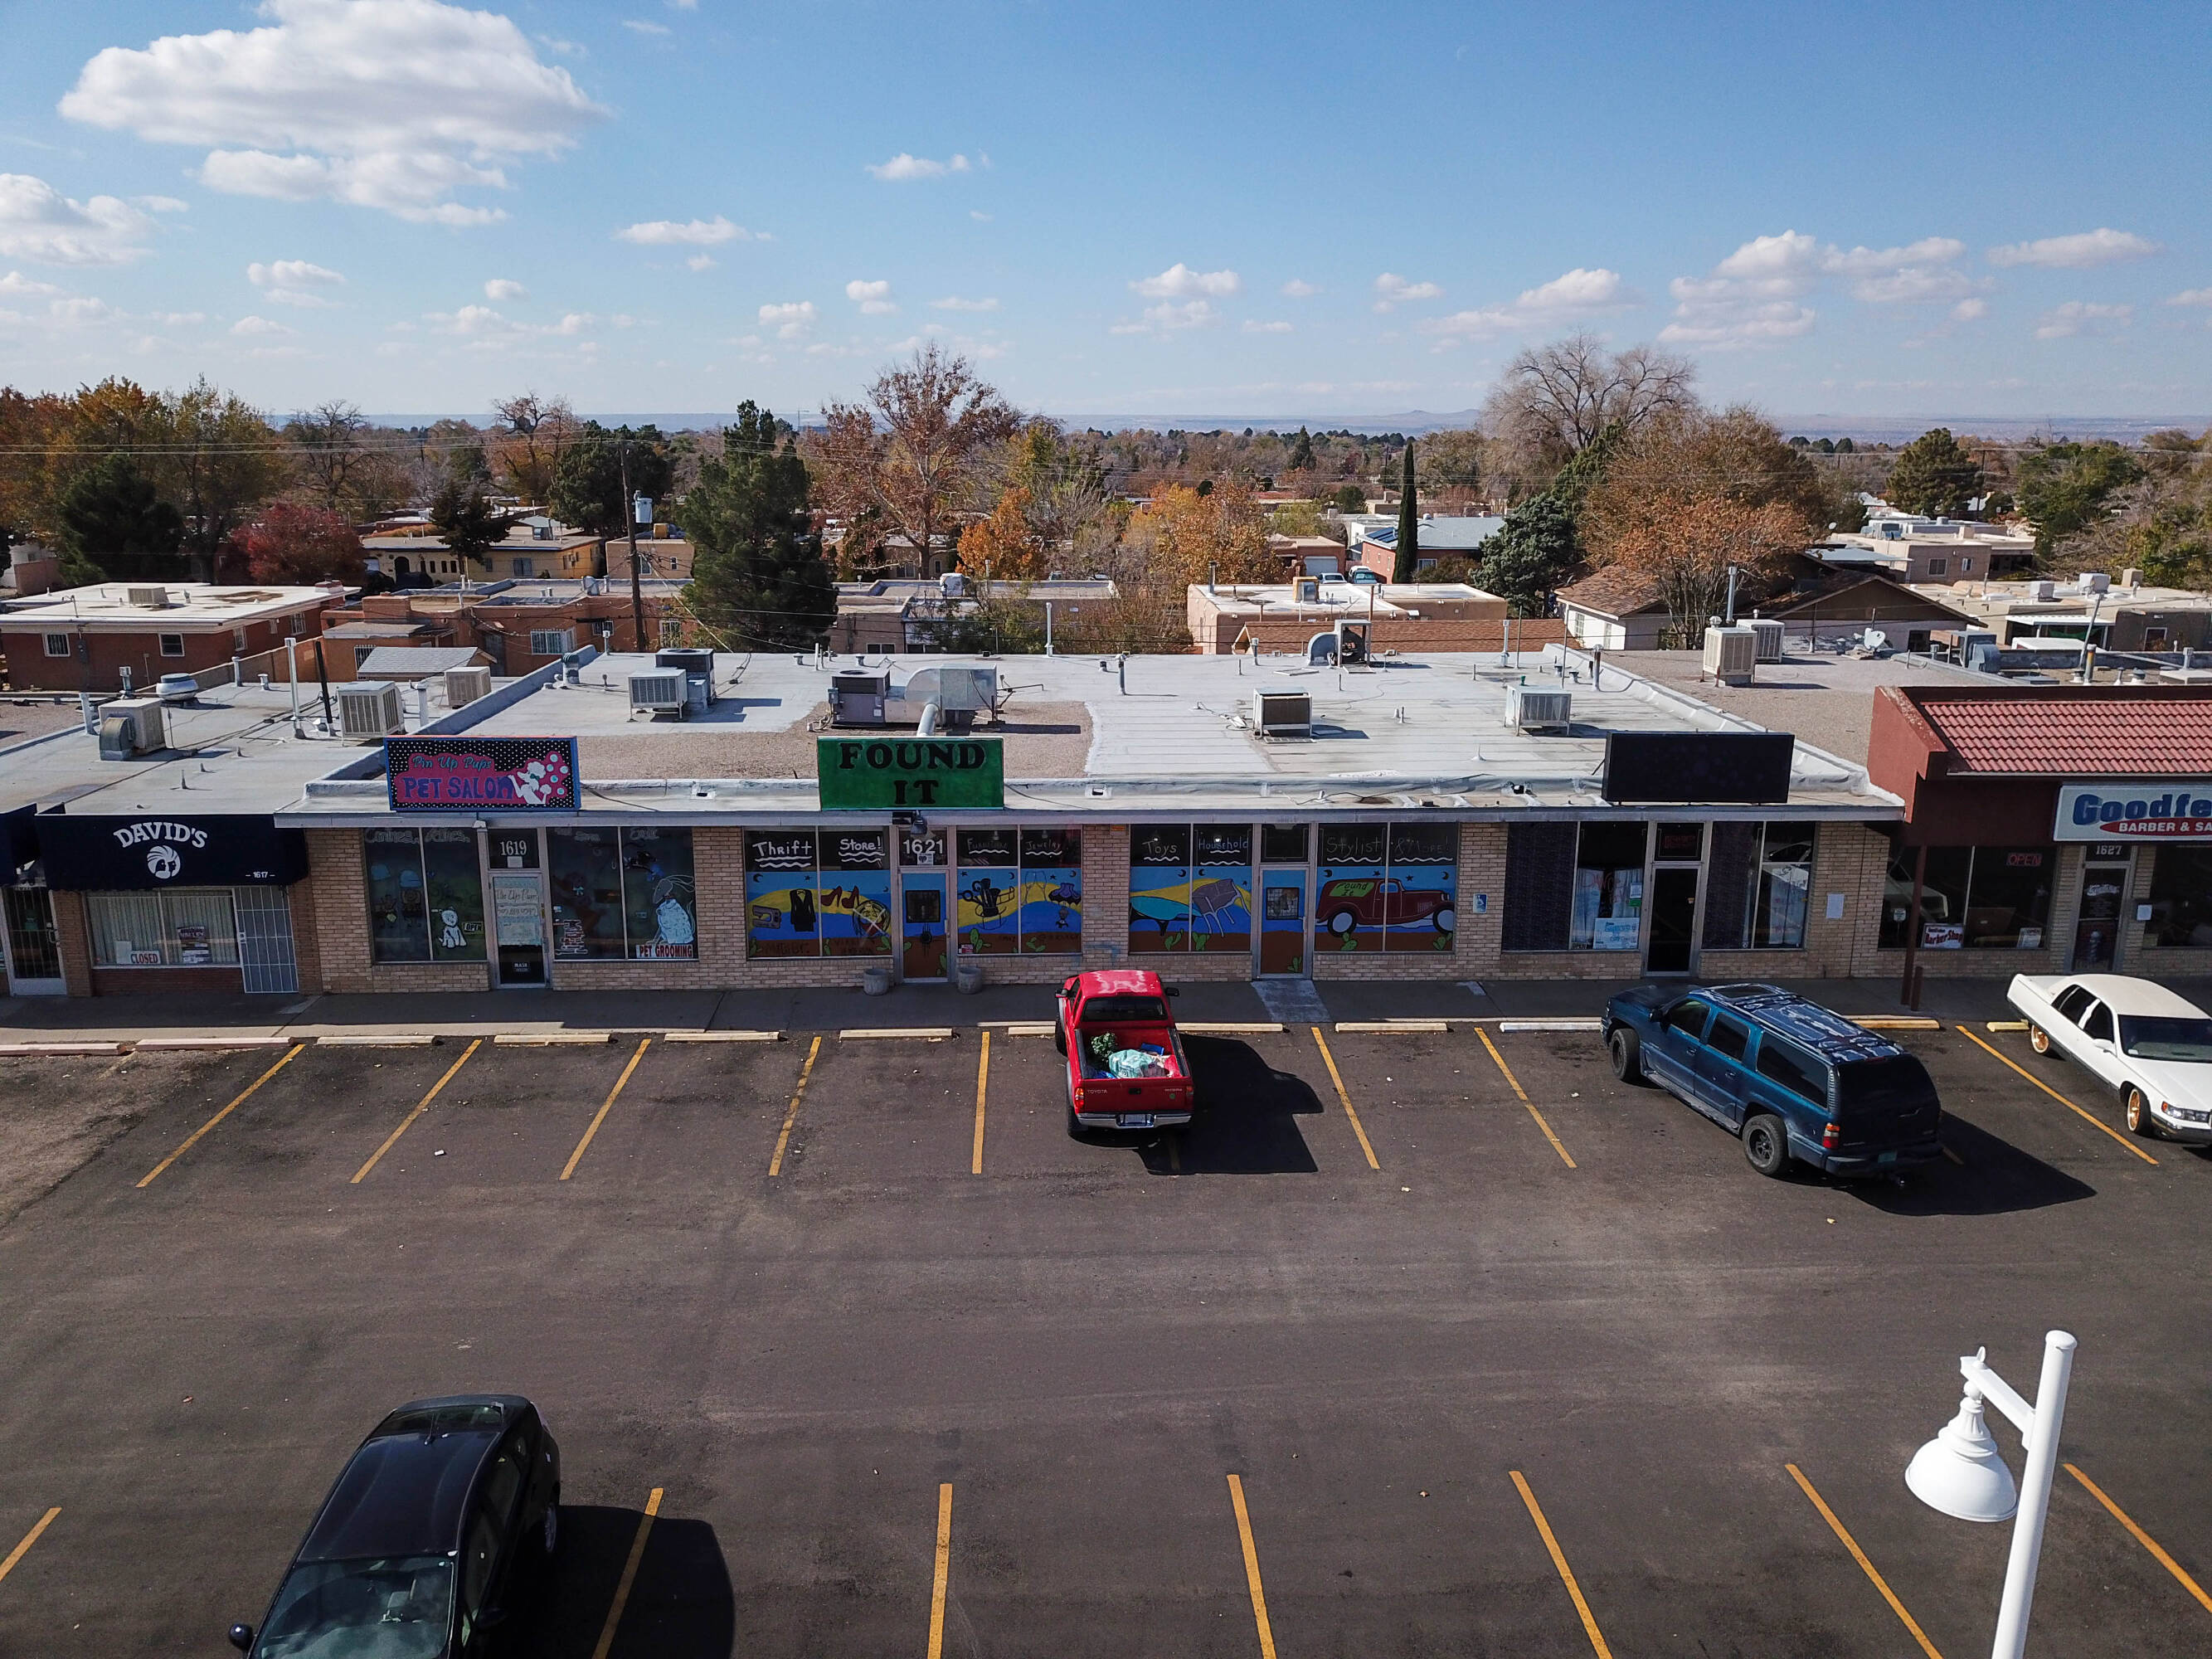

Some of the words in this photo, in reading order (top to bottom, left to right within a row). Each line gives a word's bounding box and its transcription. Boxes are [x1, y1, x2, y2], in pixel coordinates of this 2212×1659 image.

[412, 756, 433, 769] Pin
[438, 756, 458, 772] Up
[463, 756, 492, 772] Pups
[839, 742, 985, 770] FOUND
[403, 777, 442, 799] PET
[893, 780, 939, 805] IT
[2118, 821, 2176, 832] BARBER
[2180, 821, 2190, 832] &
[113, 821, 208, 849] DAVID'S
[499, 840, 527, 857] 1619
[752, 839, 813, 857] Thrift
[902, 839, 943, 854] 1621
[1141, 840, 1178, 858] Toys
[2095, 844, 2123, 855] 1627
[2009, 854, 2042, 865] OPEN
[130, 952, 158, 964] CLOSED
[639, 945, 652, 957] PET
[655, 945, 693, 957] GROOMING
